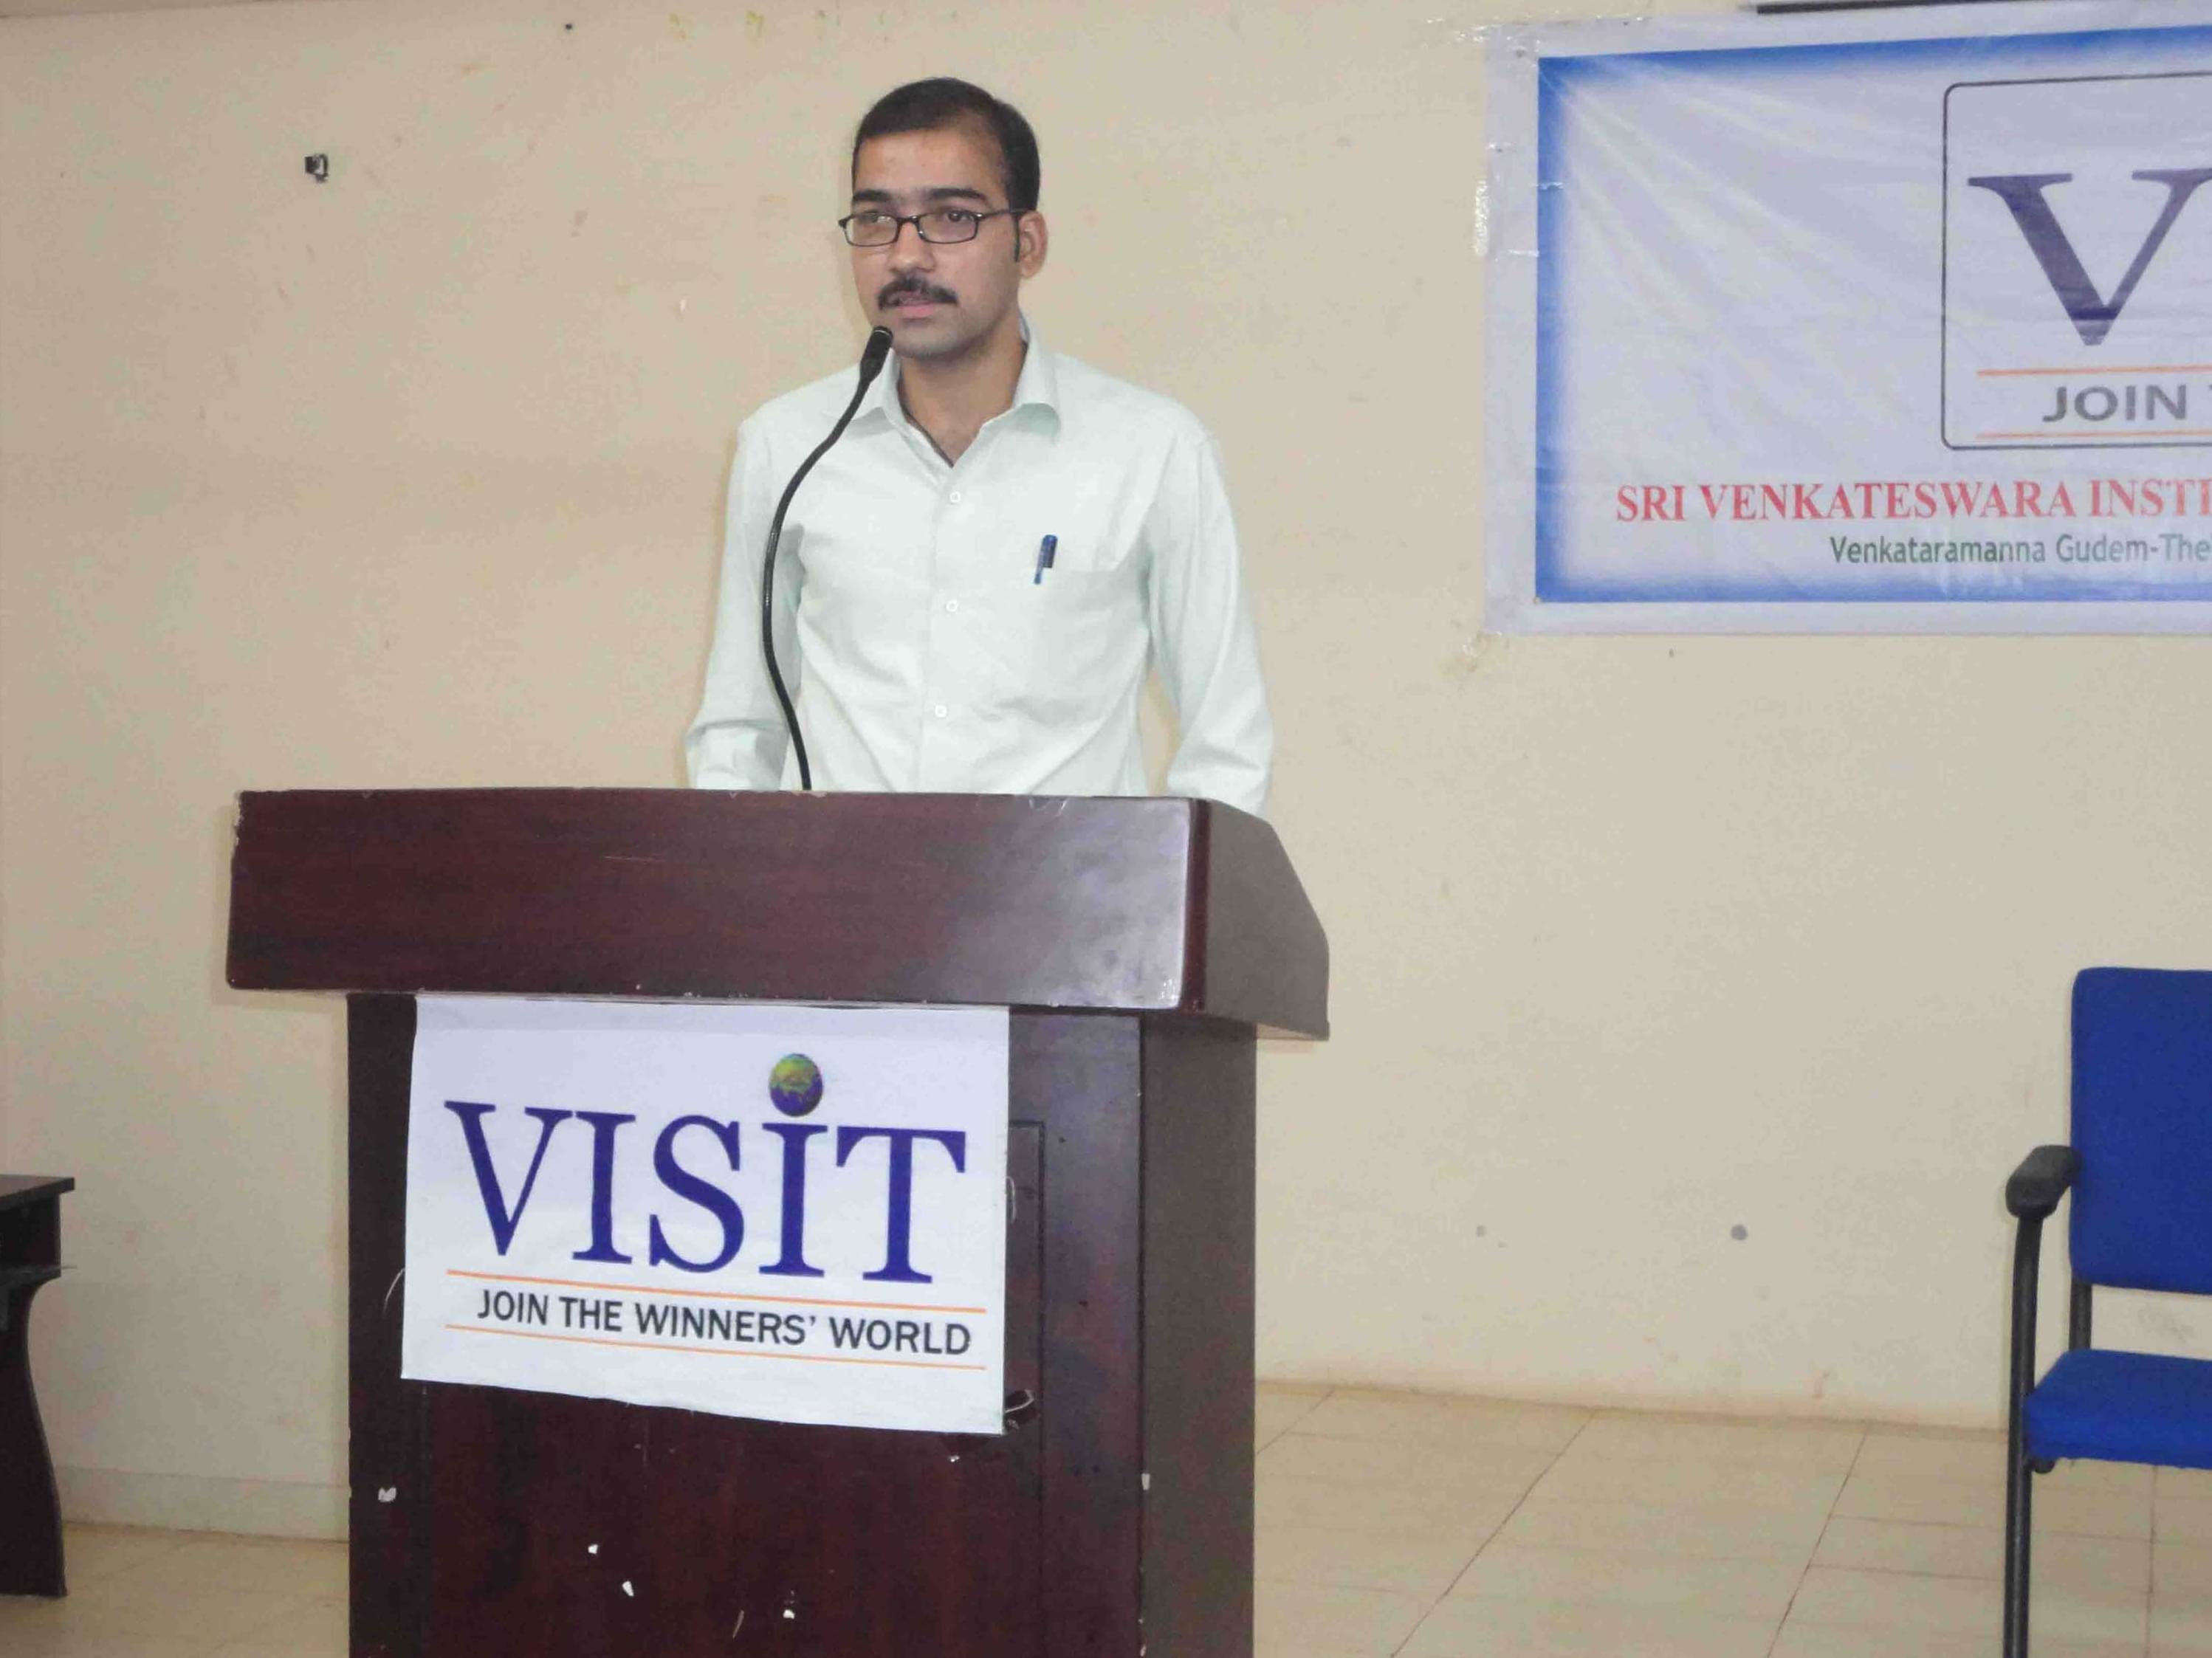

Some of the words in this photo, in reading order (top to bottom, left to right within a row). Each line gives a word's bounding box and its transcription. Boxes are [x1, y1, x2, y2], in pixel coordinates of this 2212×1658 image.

[2041, 384, 2187, 423] JOIN
[1616, 484, 1686, 523] SRI
[1700, 479, 2076, 521] VENKATESWARA
[1830, 535, 2046, 565] Venkataramanna
[2055, 532, 2212, 563] Gudem-The
[477, 1289, 549, 1327] JOIN
[558, 1296, 623, 1333] THE
[828, 1316, 972, 1356] WORLD
